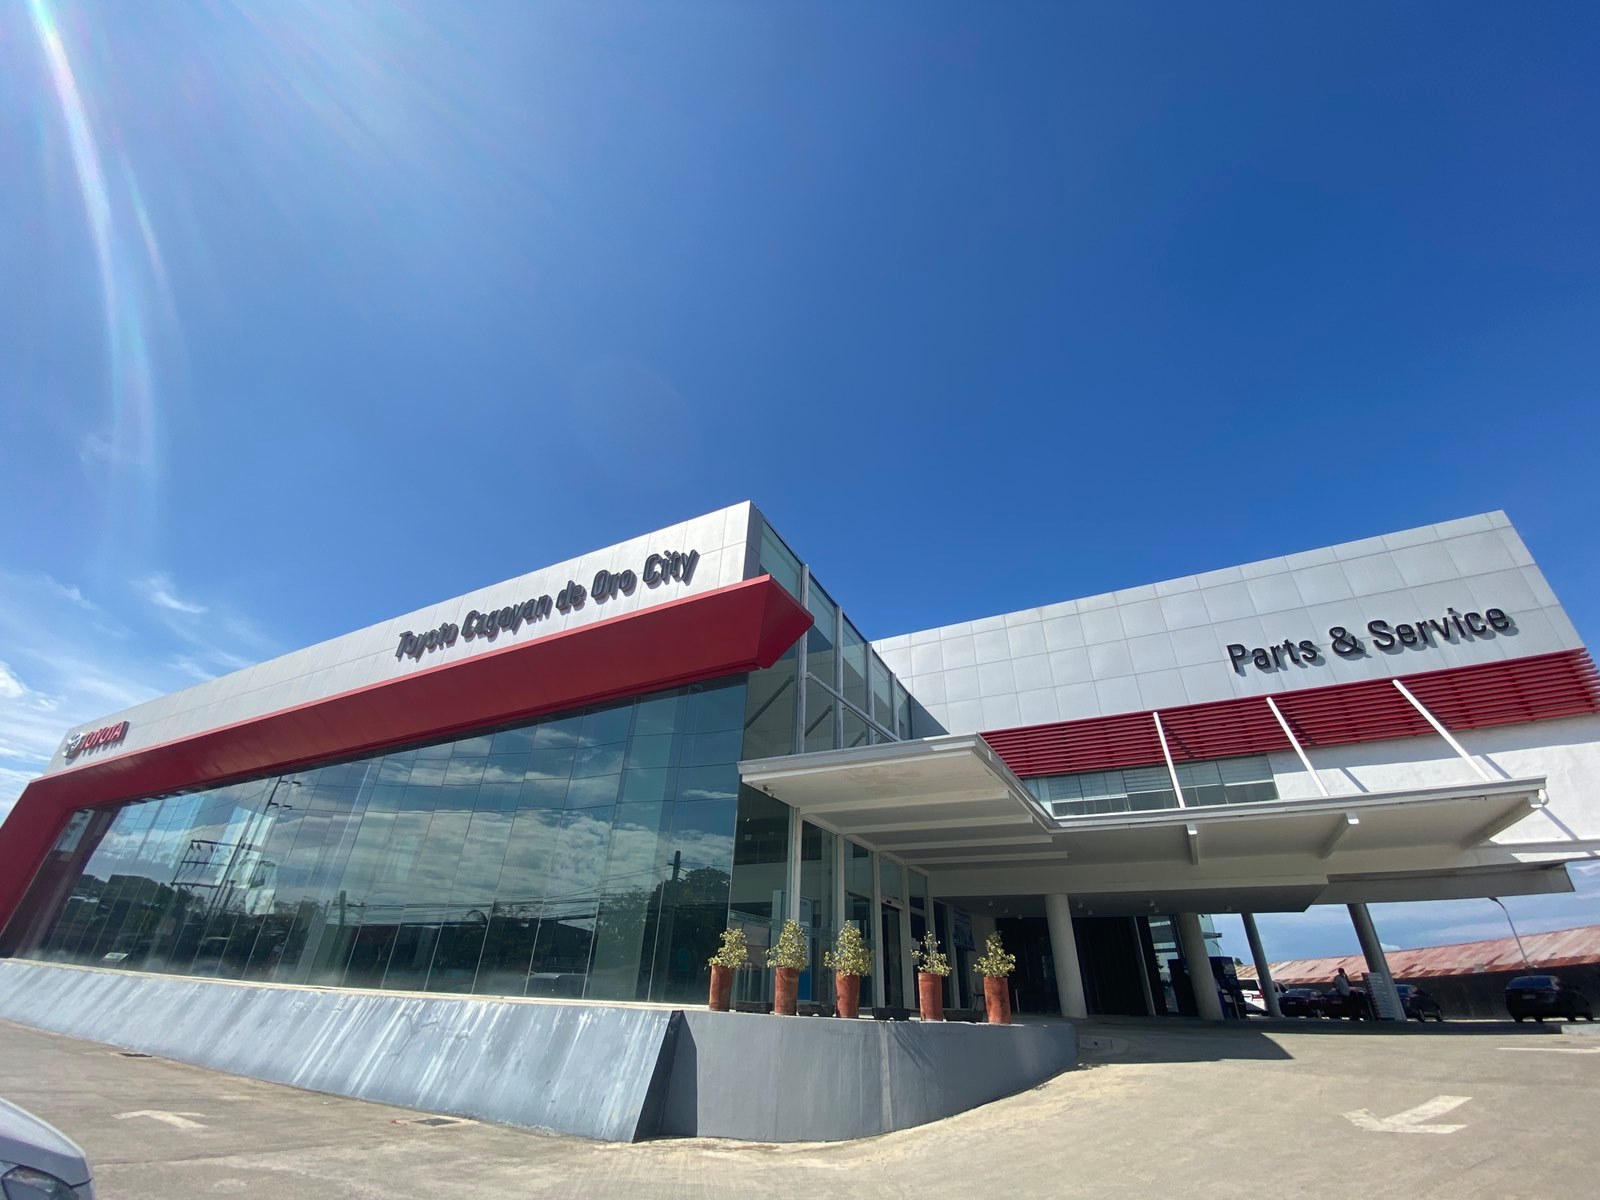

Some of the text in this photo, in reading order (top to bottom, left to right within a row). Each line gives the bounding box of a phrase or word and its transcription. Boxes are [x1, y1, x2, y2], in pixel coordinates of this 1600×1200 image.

[395, 549, 700, 662] Toyota Cagayan de Oro City
[1226, 607, 1510, 673] Parts & Service
[80, 721, 128, 750] TOYOTA
